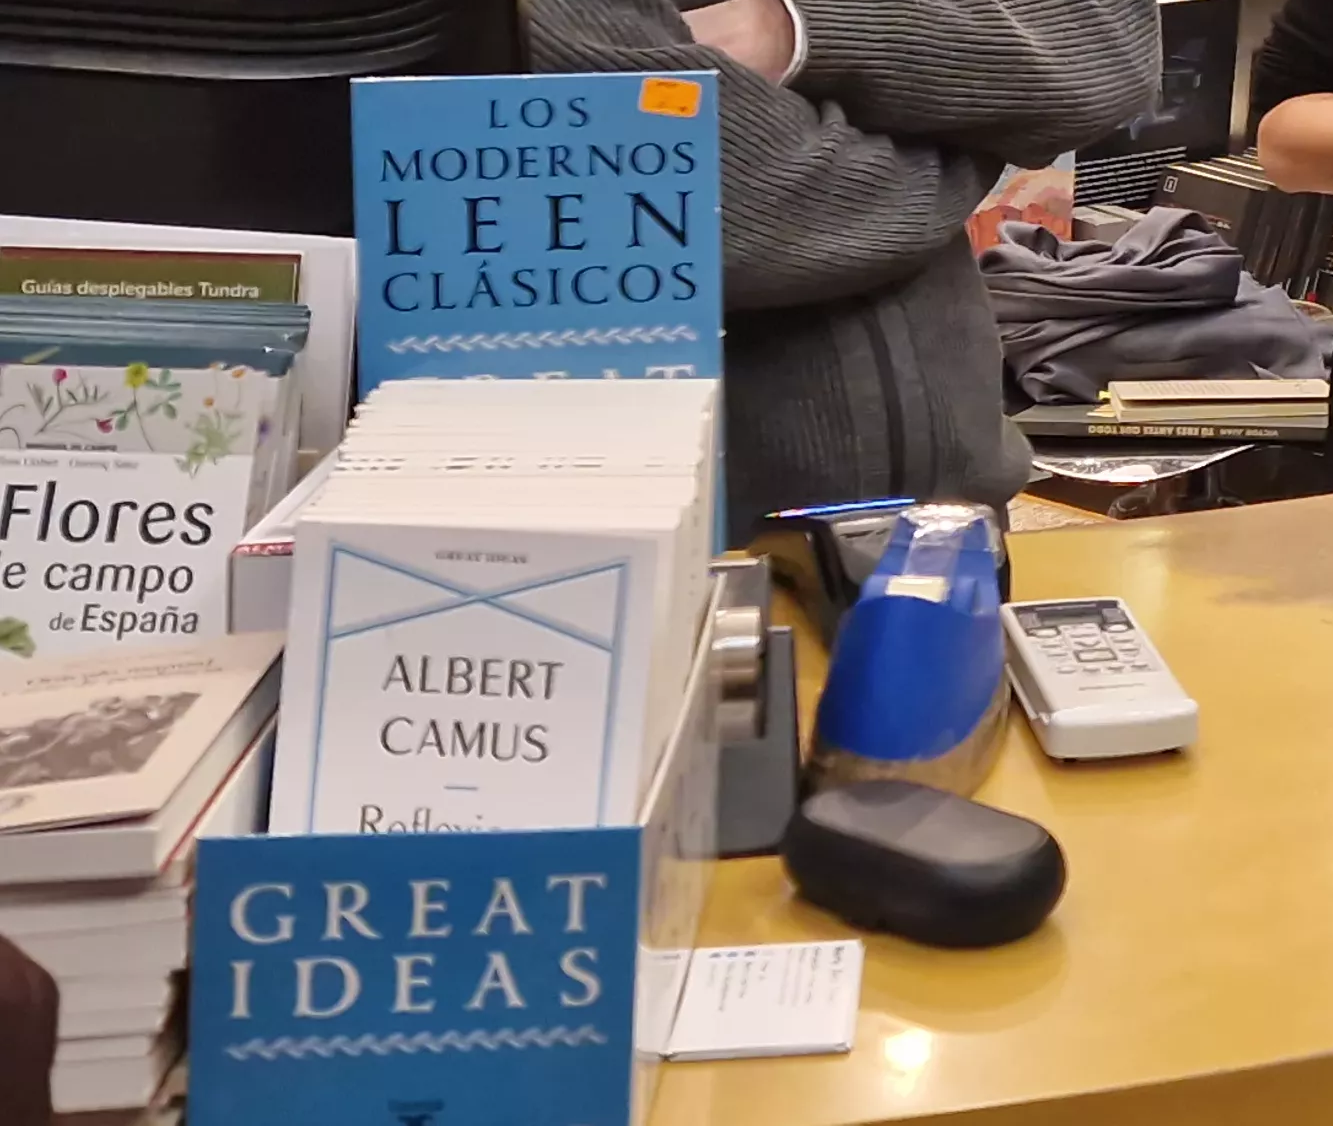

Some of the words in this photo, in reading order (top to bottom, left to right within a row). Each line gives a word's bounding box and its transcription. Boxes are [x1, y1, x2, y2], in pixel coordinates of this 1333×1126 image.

[489, 96, 591, 129] LOS
[381, 142, 697, 184] MODERNOS
[385, 190, 694, 256] LEEN
[22, 280, 71, 296] Guías
[76, 281, 193, 300] desplegables
[198, 281, 259, 299] Tundra
[382, 262, 697, 312] CLÁSICOS
[1087, 425, 1117, 434] TODO
[1143, 426, 1174, 436] ANTES
[0, 481, 213, 545] Flores
[0, 550, 26, 590] e
[44, 562, 194, 604] campo
[50, 612, 75, 631] de
[80, 604, 200, 640] España
[381, 655, 564, 700] ALBERT
[380, 716, 550, 764] CAMUS
[229, 874, 606, 946] GREAT
[229, 947, 603, 1020] IDEAS
